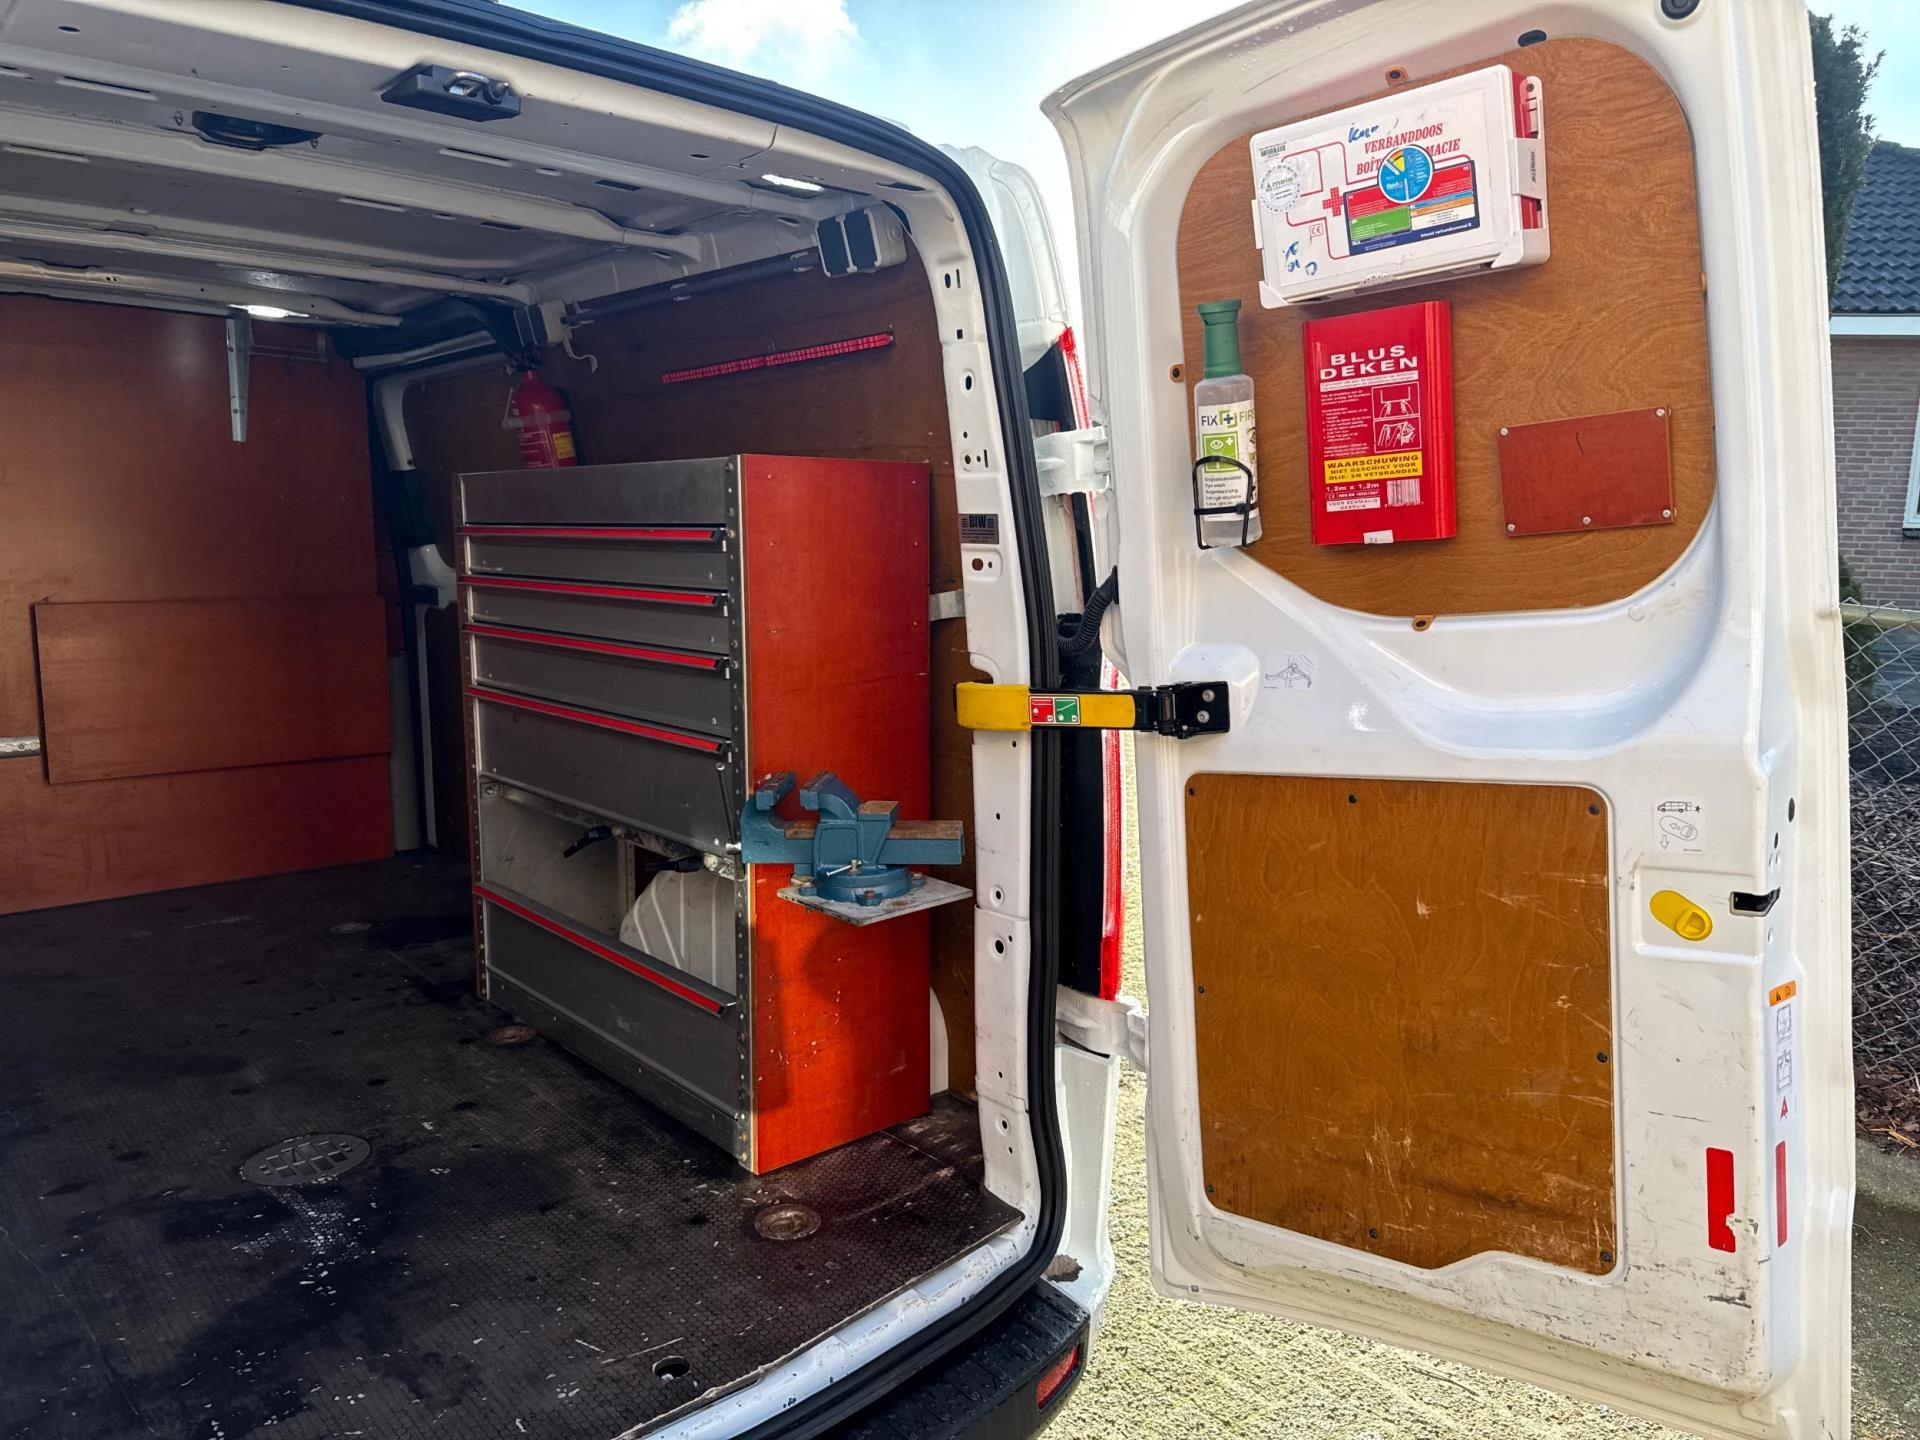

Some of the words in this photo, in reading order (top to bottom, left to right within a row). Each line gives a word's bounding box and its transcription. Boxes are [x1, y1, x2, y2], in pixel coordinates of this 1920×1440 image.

[1364, 123, 1443, 154] VERBANDDOOS
[1356, 157, 1381, 176] BOÎT
[1426, 138, 1461, 156] MACIE
[1330, 344, 1406, 366] BLUS
[1320, 356, 1418, 380] DEKEN
[1201, 415, 1218, 426] FIX
[1327, 454, 1419, 469] WAARSCHUWING
[1350, 464, 1391, 473] GESCHIKT
